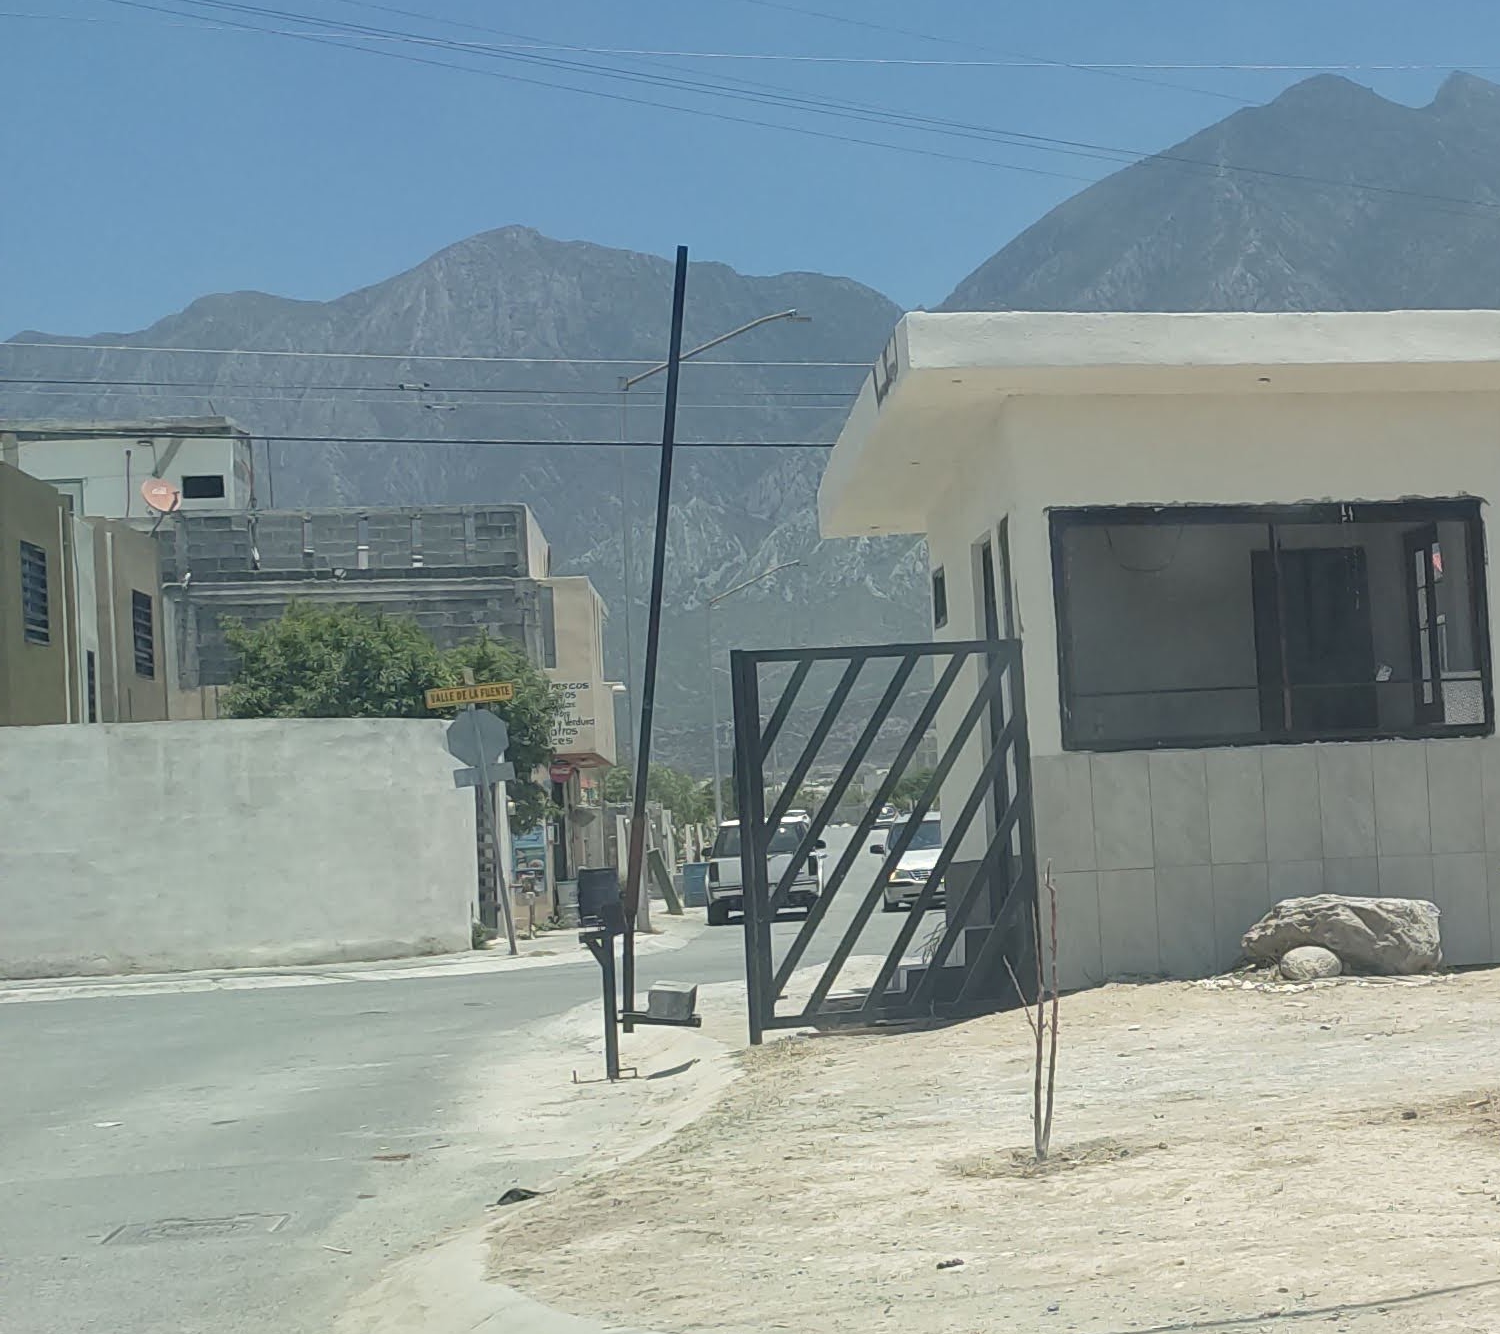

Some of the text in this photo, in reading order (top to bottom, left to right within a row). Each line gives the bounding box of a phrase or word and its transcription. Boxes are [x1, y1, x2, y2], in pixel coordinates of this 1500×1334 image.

[430, 685, 510, 704] VALLE DE LA FUENTE
